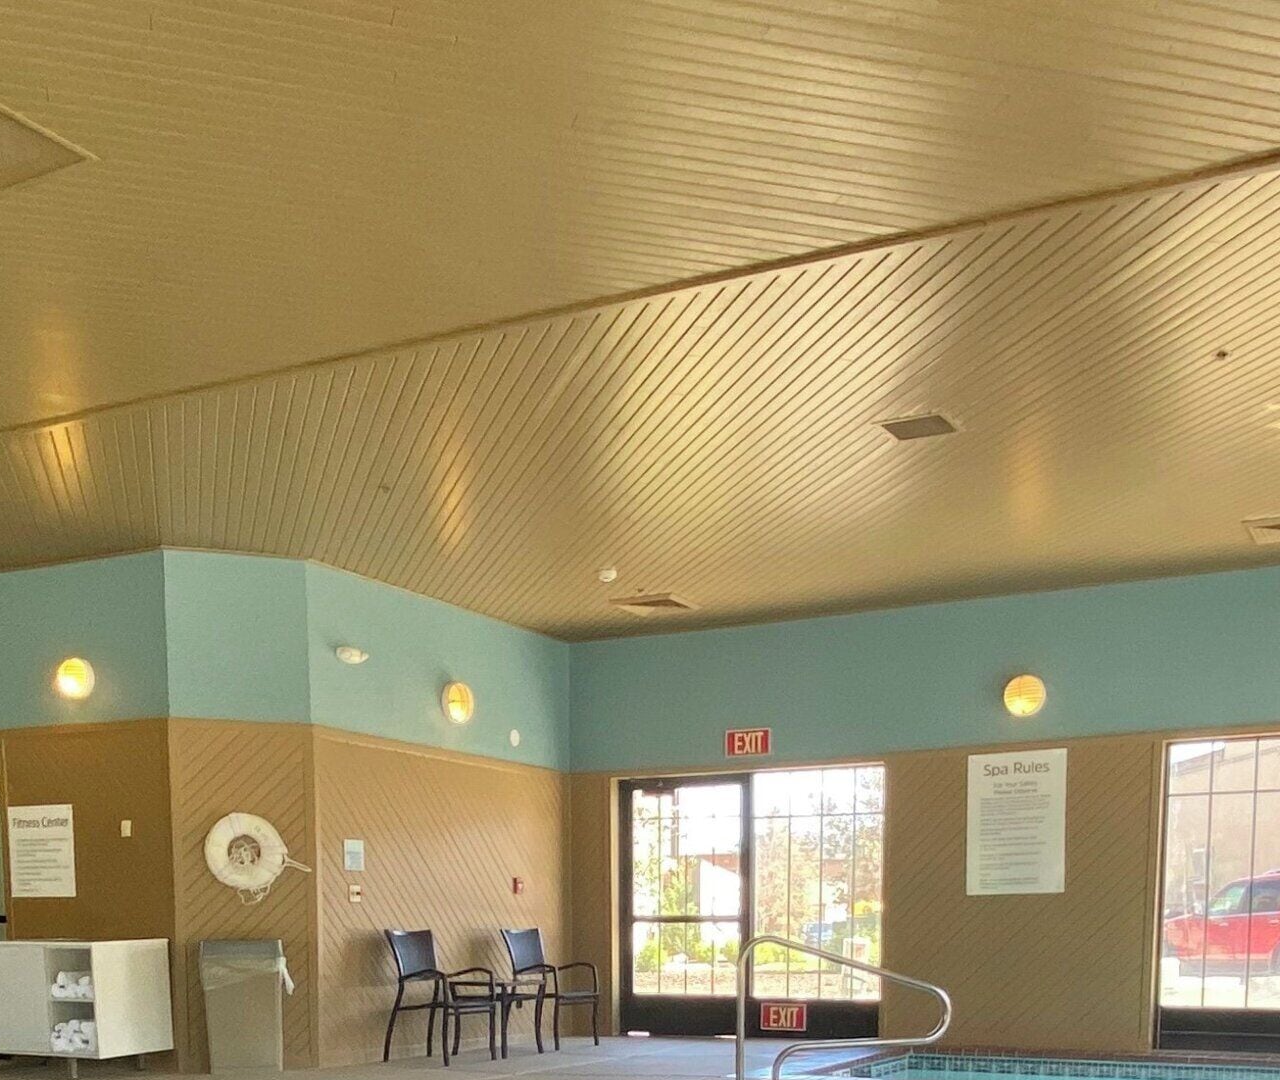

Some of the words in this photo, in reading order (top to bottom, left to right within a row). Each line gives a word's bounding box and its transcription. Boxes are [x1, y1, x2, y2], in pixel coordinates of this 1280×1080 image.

[734, 731, 764, 754] EXIT
[983, 764, 1009, 777] Spa
[1013, 761, 1050, 774] Rules
[12, 817, 40, 829] Fitness
[41, 816, 69, 828] Center
[770, 1006, 799, 1028] EXIT
